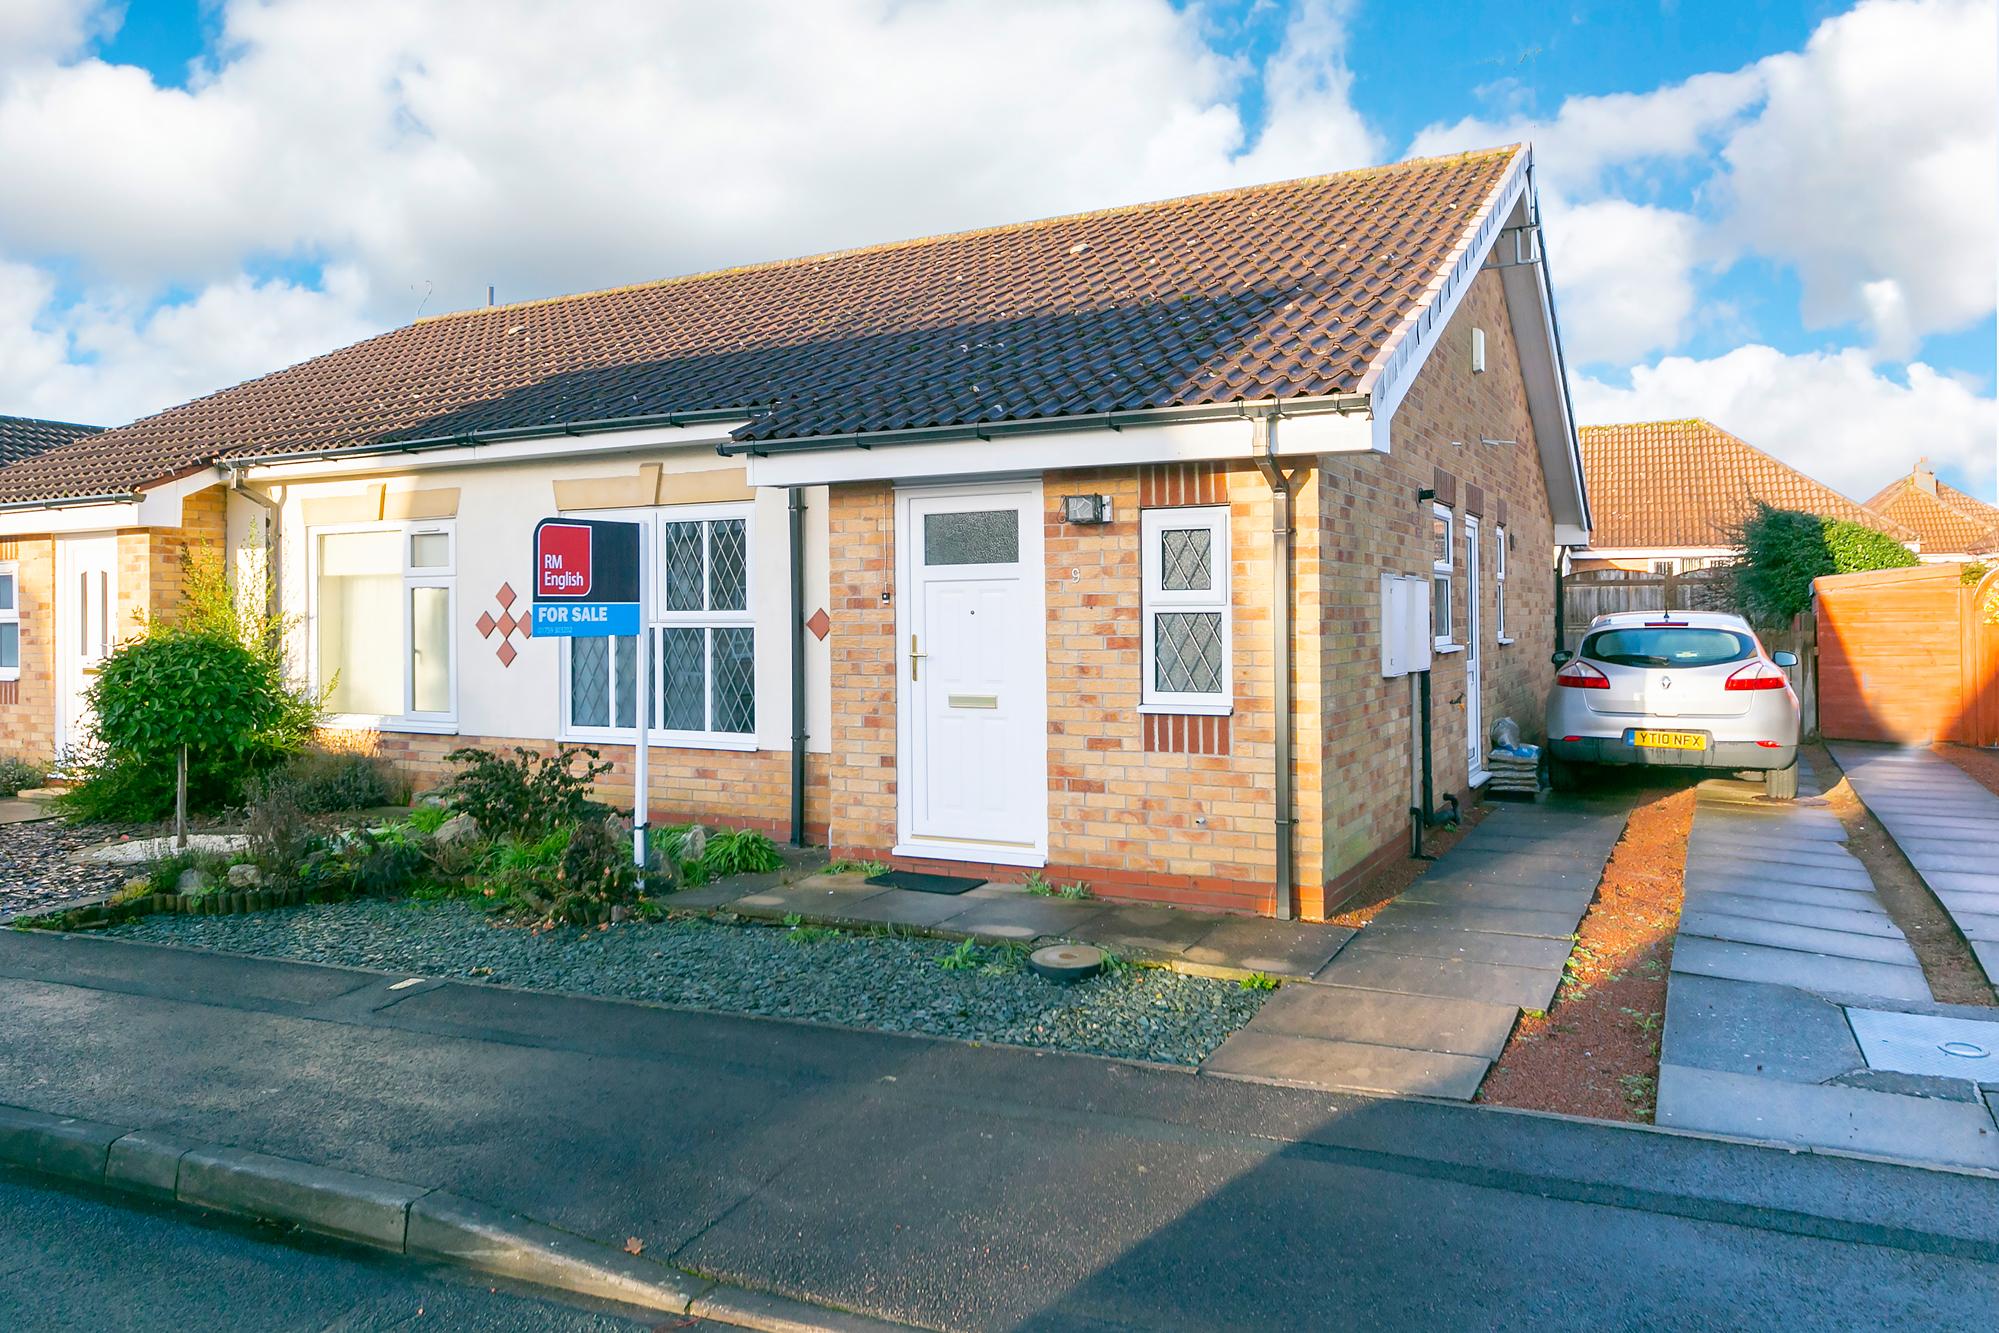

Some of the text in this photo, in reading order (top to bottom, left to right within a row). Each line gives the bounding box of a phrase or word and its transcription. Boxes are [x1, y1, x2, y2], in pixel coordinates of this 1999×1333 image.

[545, 554, 562, 569] RM
[545, 571, 584, 590] English
[1071, 568, 1080, 583] 9
[538, 607, 608, 622] FOR SALE
[1640, 733, 1700, 746] YT10 NFX
